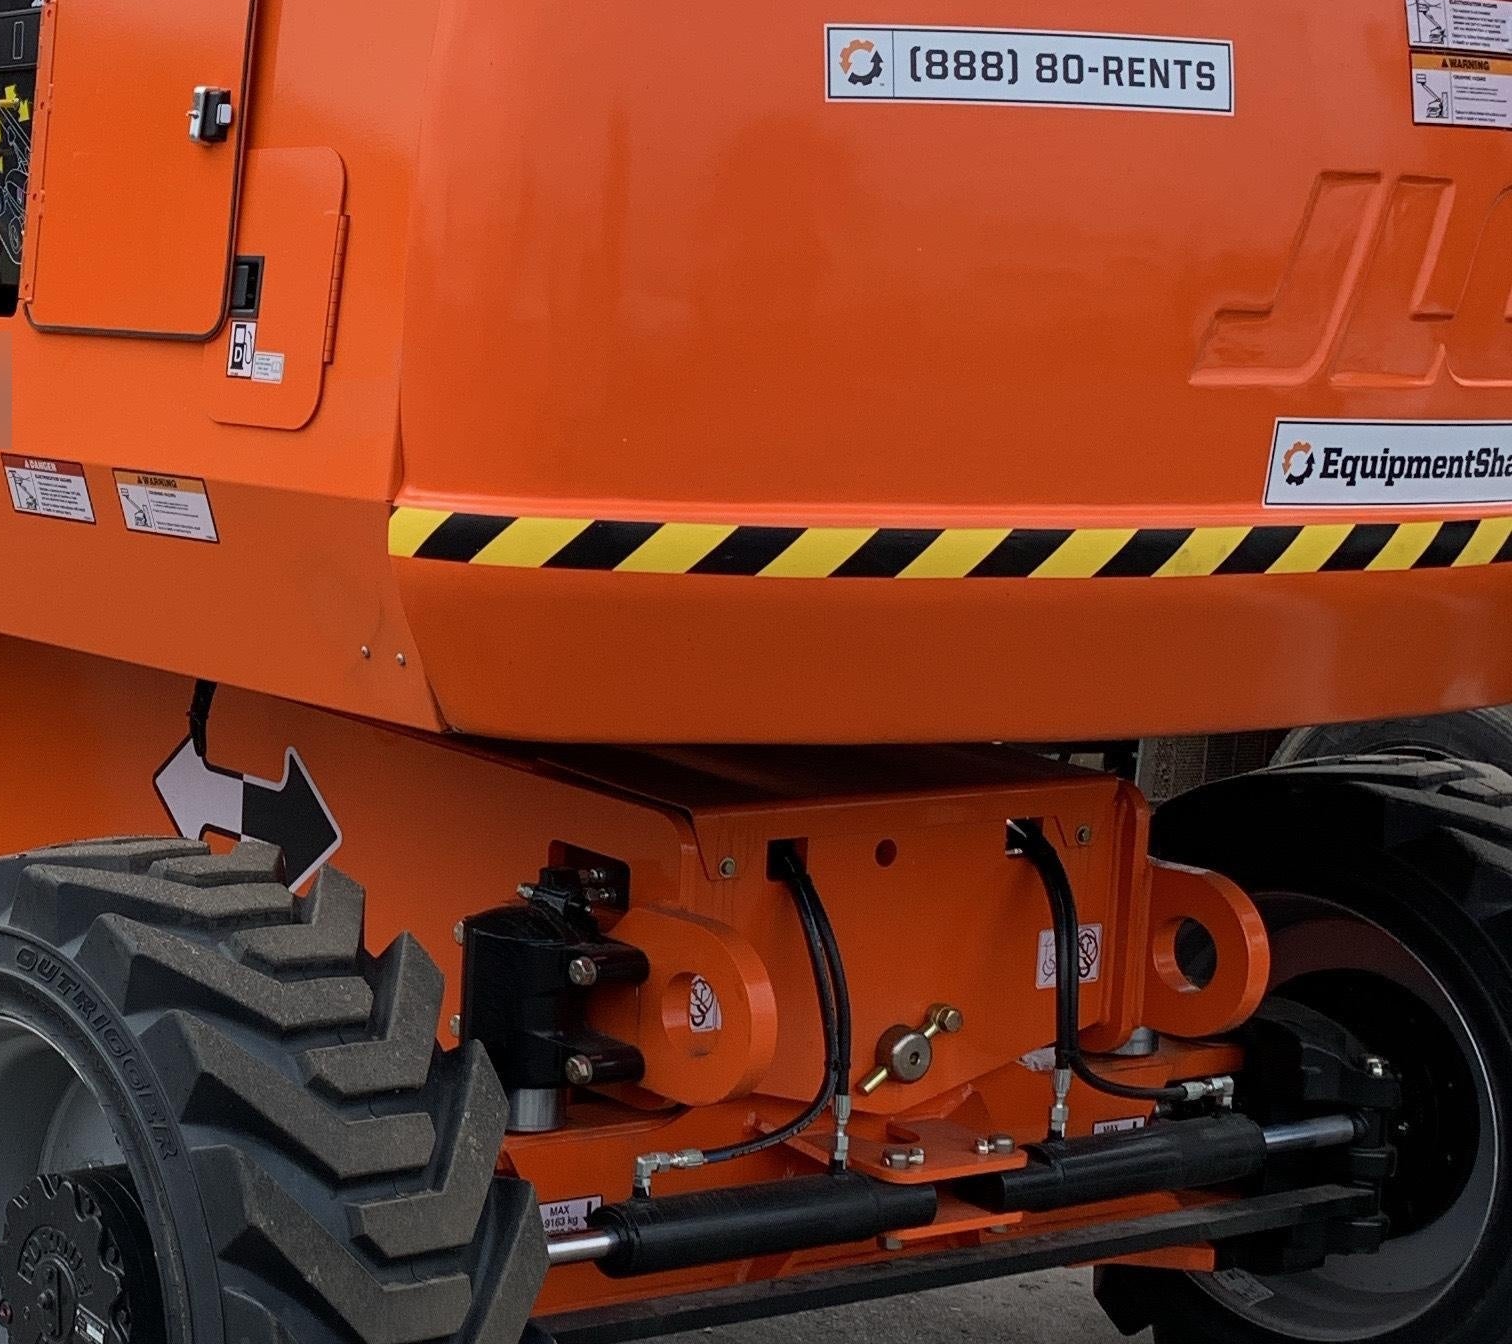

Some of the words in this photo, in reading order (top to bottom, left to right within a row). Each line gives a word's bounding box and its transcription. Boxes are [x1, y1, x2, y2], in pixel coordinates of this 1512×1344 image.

[910, 45, 1018, 85] (888)
[1035, 52, 1216, 91] 80-RENTS
[1449, 58, 1490, 71] WARNING
[142, 476, 178, 489] WARNING
[16, 947, 178, 1160] OUTRIGGER
[549, 1204, 570, 1217] MAX
